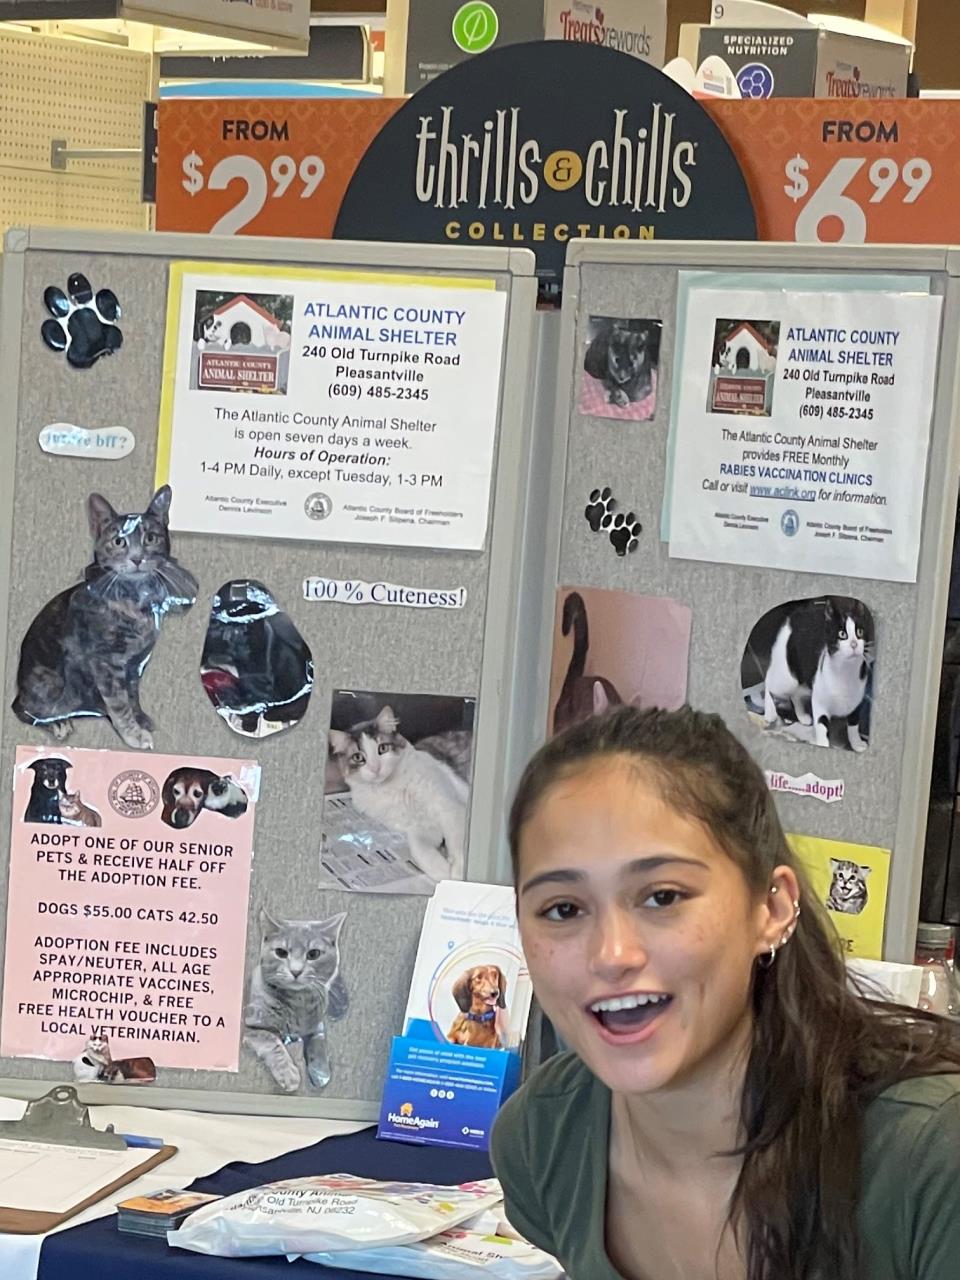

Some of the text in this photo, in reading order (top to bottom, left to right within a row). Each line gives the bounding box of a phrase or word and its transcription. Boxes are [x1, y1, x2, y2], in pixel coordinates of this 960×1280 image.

[605, 25, 651, 56] rewards
[724, 35, 794, 46] SPECIALIZED
[727, 45, 788, 56] NUTRITION
[222, 120, 289, 141] FROM
[822, 120, 898, 143] FROM
[415, 106, 542, 210] thrills
[584, 102, 694, 213] chills
[445, 222, 655, 241] COLLECTION
[304, 303, 466, 325] ATLANTIC COUNTY
[309, 324, 457, 346] ANIMAL SHELTER
[787, 328, 900, 345] ATLANTIC COUNTY
[302, 346, 460, 367] 240 Old Turnpike Road
[788, 348, 893, 367] ANIMAL SHELTER
[202, 368, 274, 384] ANIMAL SHELTER
[336, 365, 424, 384] Pleasantville
[783, 369, 894, 386] 240 Old Turnpike Road
[328, 384, 429, 401] (609) 485-2345
[805, 387, 870, 403] Pleasantville
[214, 407, 437, 433] The Atlantic County Animal Shelter
[799, 404, 874, 420] (609) 485-2345
[234, 428, 412, 450] is open seven days a week.
[254, 446, 391, 467] Hours of Operation:
[742, 450, 849, 469] provides FREE Monthly
[200, 461, 443, 488] 1-4 PM Daily, except Tuesday, 1-3 PM
[720, 464, 873, 486] RABIES VACCINATION CLINICS
[702, 479, 718, 492] Call
[719, 482, 729, 492] or
[731, 481, 748, 493] visit
[818, 489, 832, 500] for
[833, 490, 887, 506] information.
[303, 580, 464, 608] 100 % Cuteness!
[30, 833, 233, 857] ADOPT ONE OF OUR SENIOR
[36, 851, 226, 874] PETS & RECEIVE HALF OFF
[59, 869, 201, 890] THE ADOPTION FEE.
[38, 902, 218, 925] DOGS $55.00 CATS 42.50
[34, 936, 217, 959] ADOPTION FEE INCLUDES
[388, 1113, 439, 1128] HomeAgain
